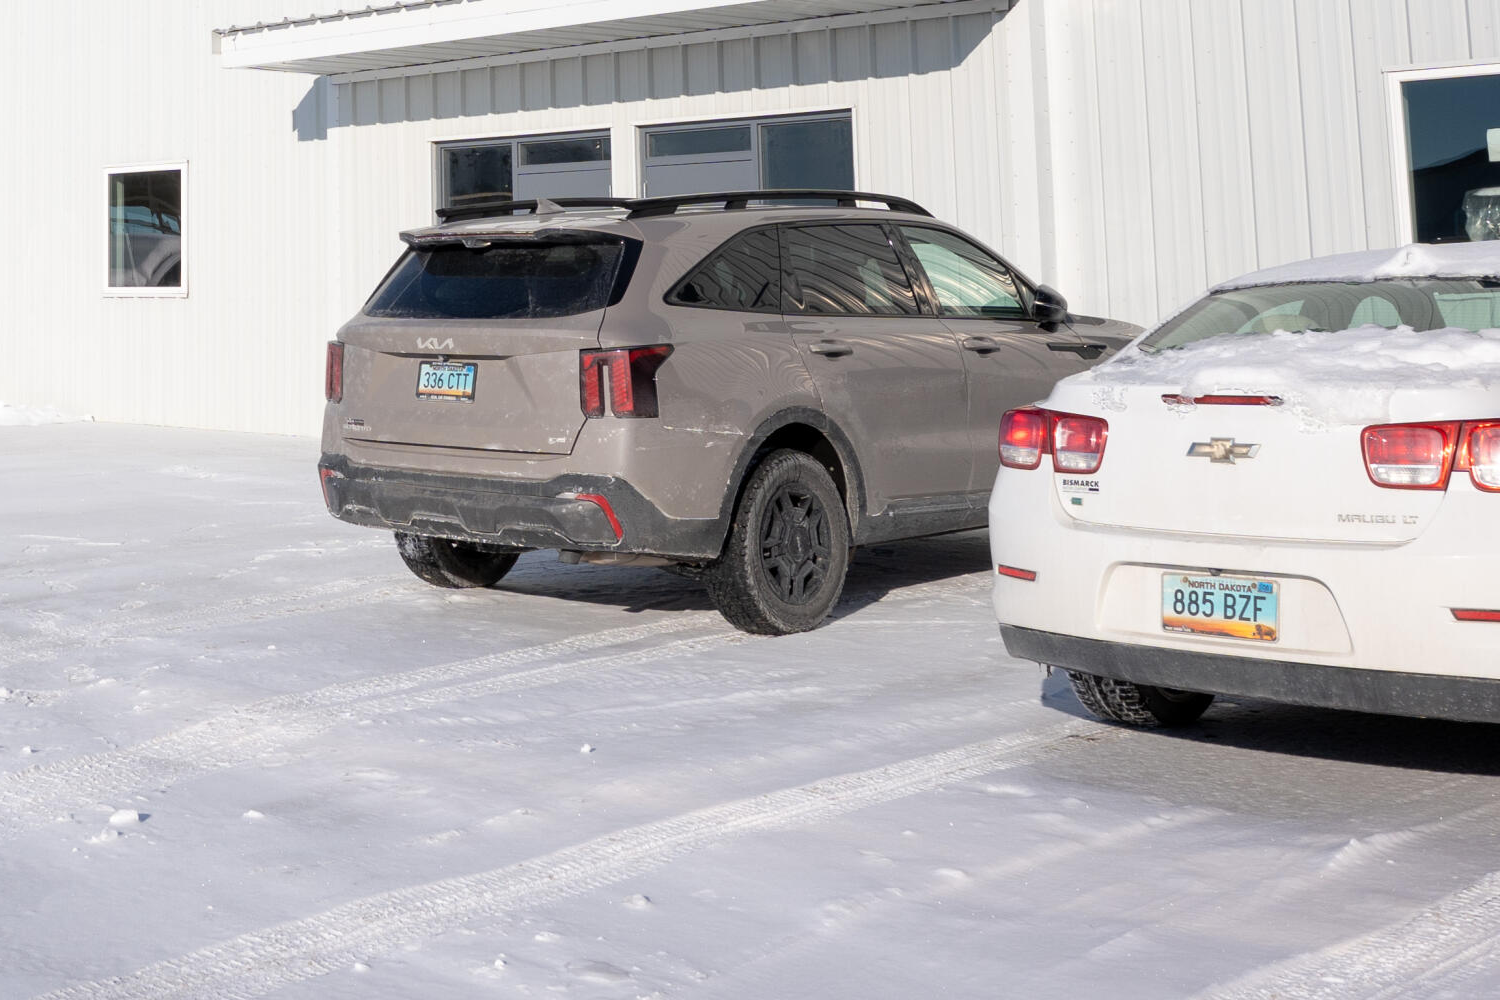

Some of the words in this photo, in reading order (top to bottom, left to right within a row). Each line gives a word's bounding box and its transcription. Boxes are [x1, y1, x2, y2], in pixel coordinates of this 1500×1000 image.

[423, 371, 444, 389] 336
[447, 372, 470, 391] CTT
[1062, 479, 1099, 488] BISMARCK
[1337, 514, 1396, 524] MALIBU
[1402, 515, 1420, 525] LT
[1187, 580, 1216, 590] NORTH
[1218, 583, 1253, 593] DAKOTA
[1173, 588, 1215, 618] 885
[1223, 592, 1267, 622] BZF
